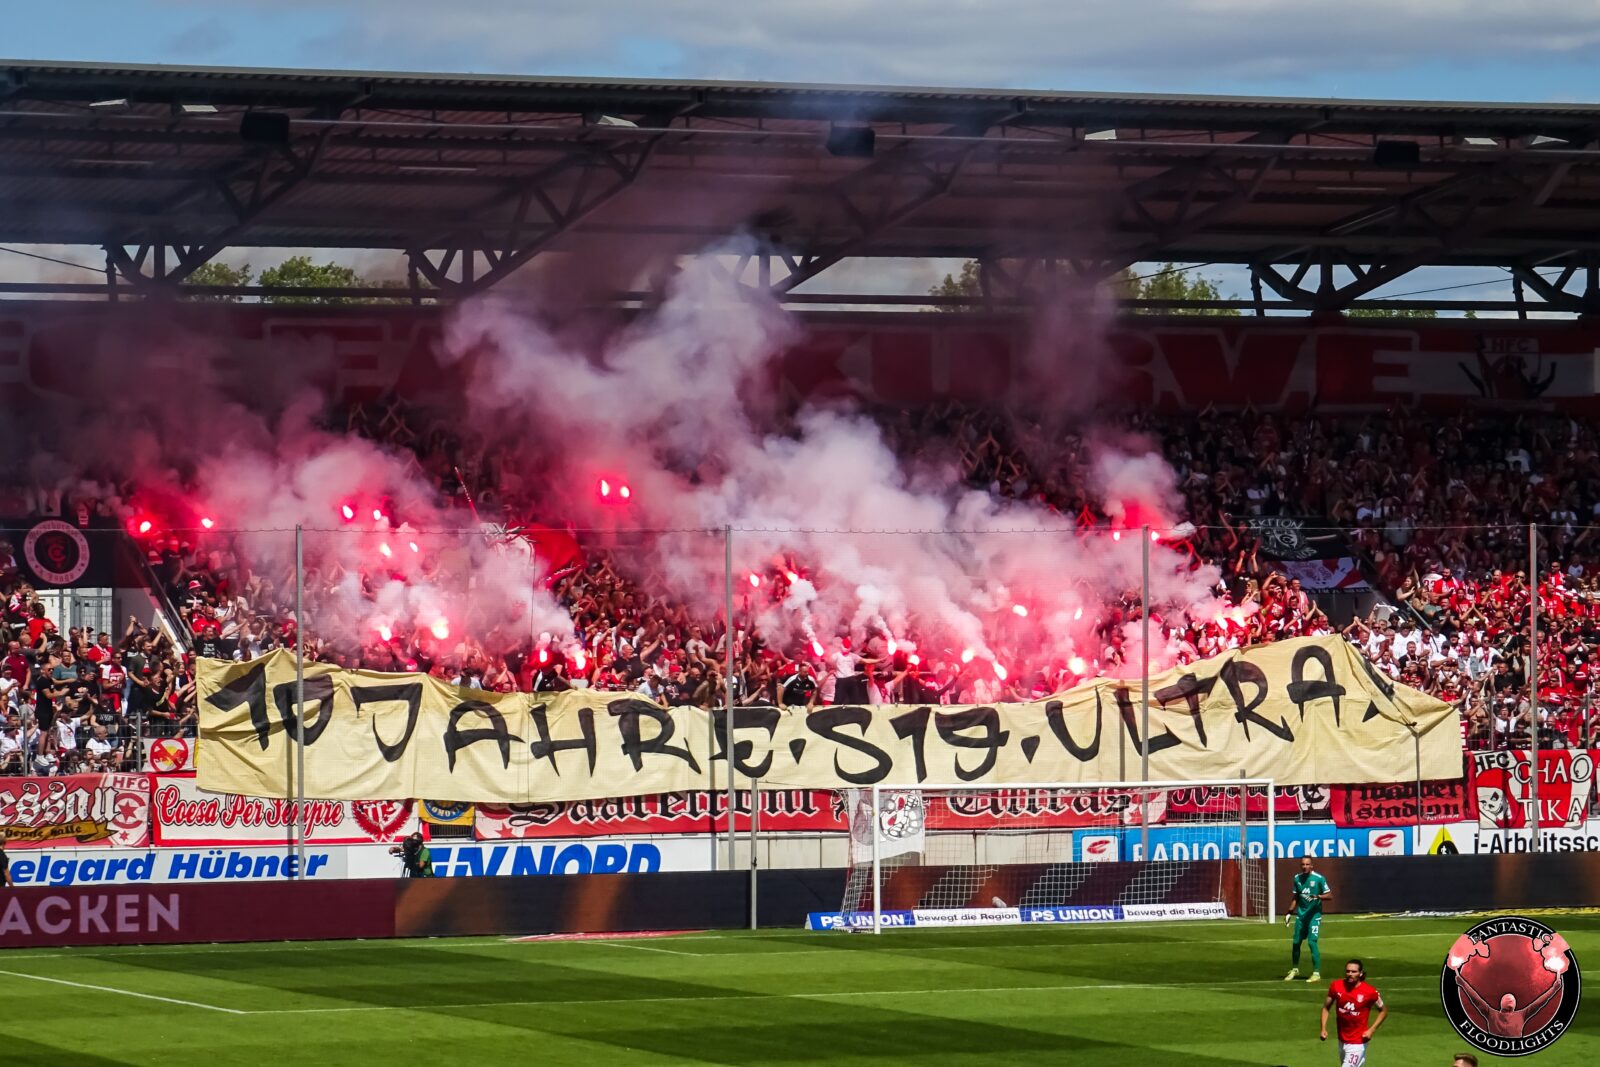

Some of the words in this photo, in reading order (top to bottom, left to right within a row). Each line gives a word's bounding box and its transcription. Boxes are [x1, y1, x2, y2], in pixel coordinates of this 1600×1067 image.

[1475, 752, 1511, 772] HFC
[112, 775, 150, 790] HFC
[220, 794, 262, 828] Per
[266, 797, 344, 839] Sempre
[1132, 842, 1221, 862] RADIO
[1228, 838, 1356, 859] BROCKEN
[168, 850, 328, 880] Hübner
[511, 843, 661, 876] NORD
[916, 913, 958, 922] bewegt
[961, 912, 978, 921] die
[980, 912, 1019, 921] Region
[1031, 909, 1056, 922] PS
[1058, 907, 1116, 921] UNION
[1126, 907, 1167, 917] bewegt
[1169, 907, 1186, 916] die
[1187, 906, 1226, 915] Region
[820, 914, 844, 928] PS
[849, 913, 906, 926] UNON
[1348, 1053, 1359, 1065] 33
